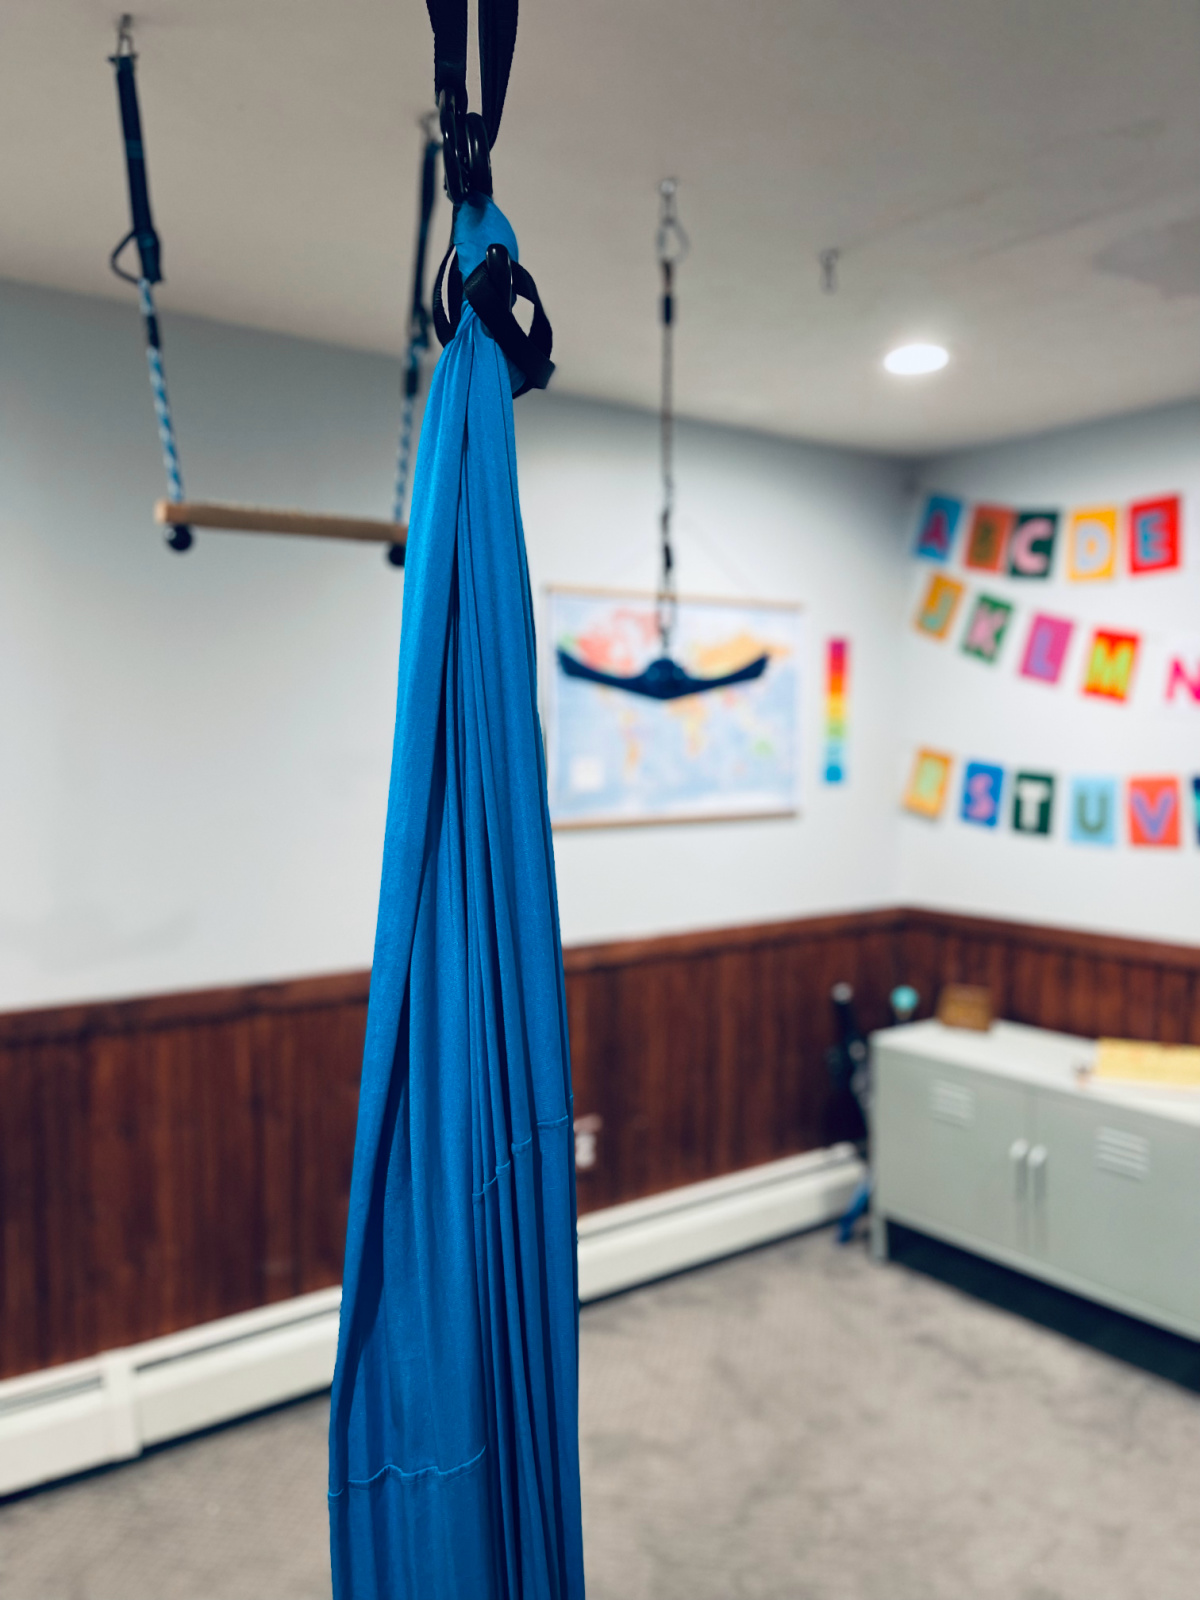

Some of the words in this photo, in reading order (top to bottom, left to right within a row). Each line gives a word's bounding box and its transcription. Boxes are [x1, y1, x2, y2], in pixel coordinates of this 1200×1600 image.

[1012, 517, 1054, 574] C
[1074, 520, 1111, 573] D
[1138, 510, 1168, 564] E
[966, 602, 1010, 656] K
[1026, 621, 1056, 678] L
[1085, 639, 1132, 692] M
[967, 772, 995, 820] S
[1018, 780, 1049, 831] T
[1077, 790, 1108, 834] U
[1131, 787, 1175, 842] V
